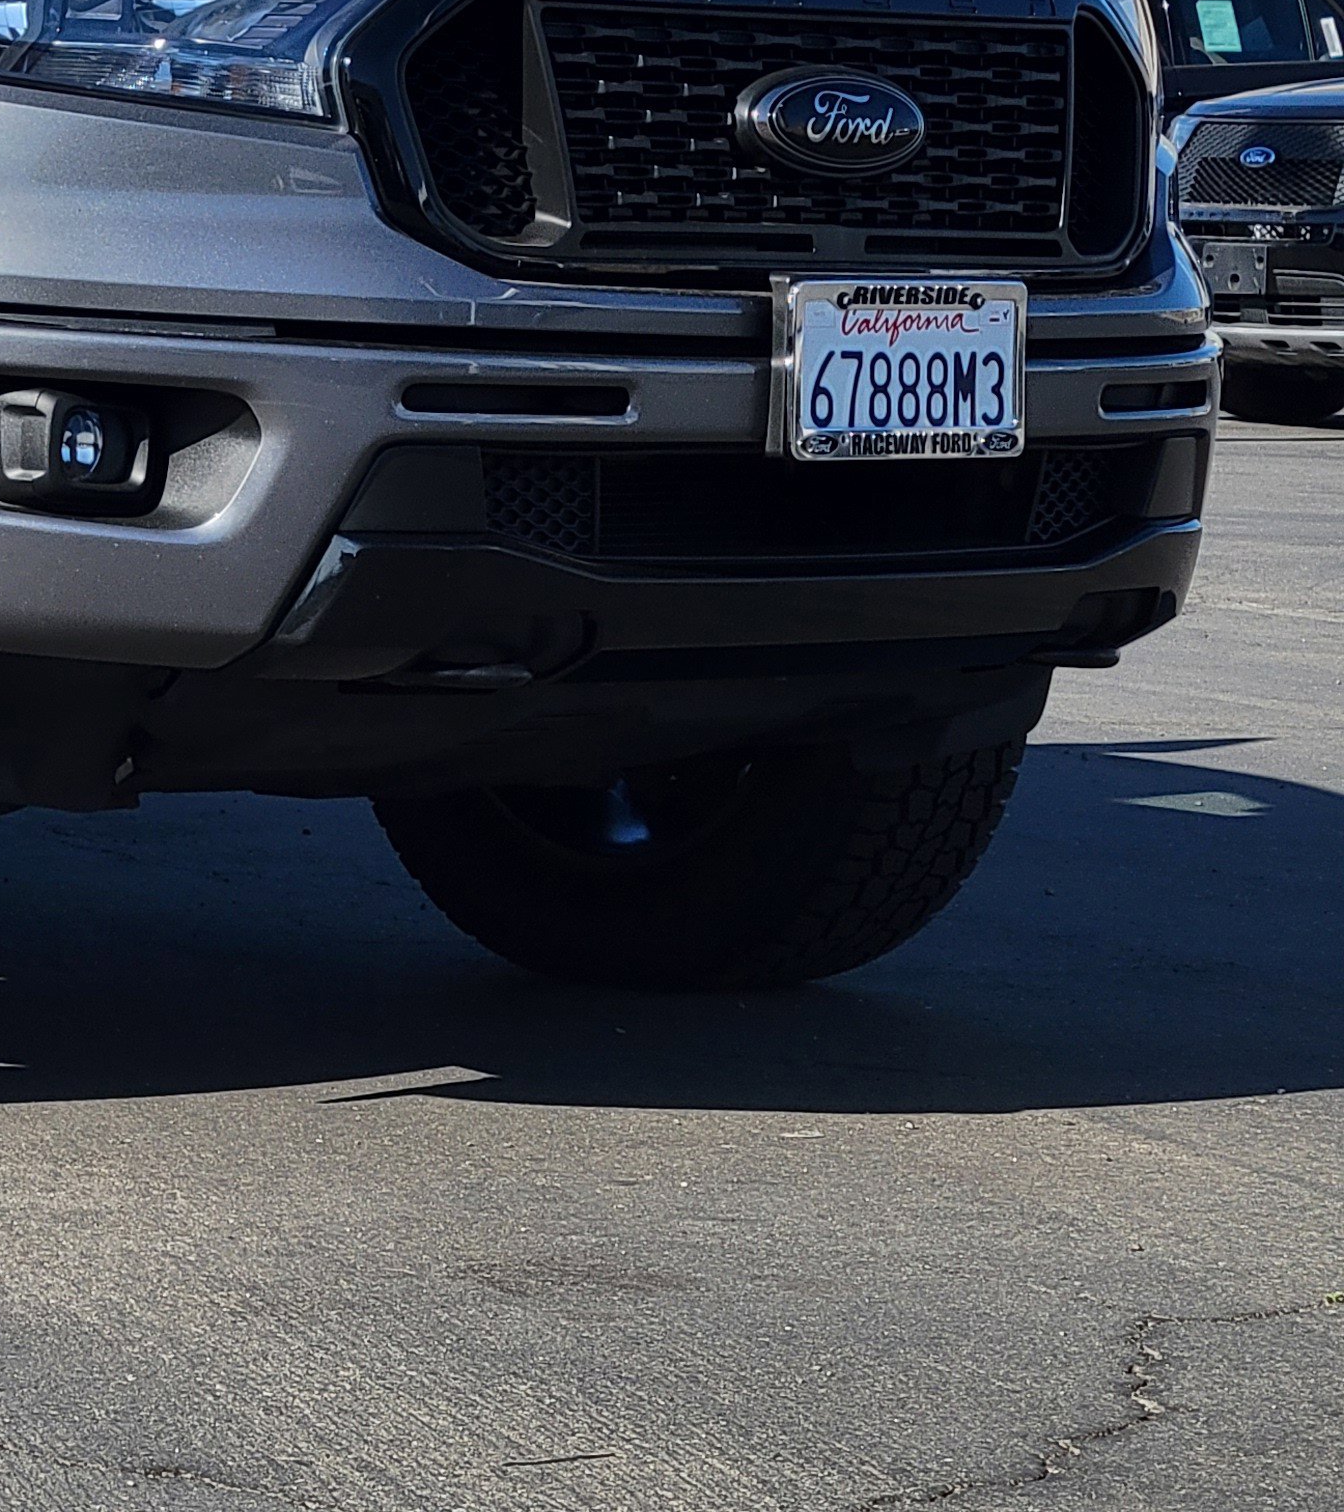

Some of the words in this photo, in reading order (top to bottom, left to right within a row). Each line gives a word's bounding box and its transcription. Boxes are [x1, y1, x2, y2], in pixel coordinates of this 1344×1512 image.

[807, 90, 894, 145] Ford
[851, 285, 970, 306] RIVERSIDE
[841, 309, 979, 347] California
[810, 350, 1004, 428] 67888M3
[852, 432, 928, 456] RACEWAY
[931, 431, 973, 455] FORD
